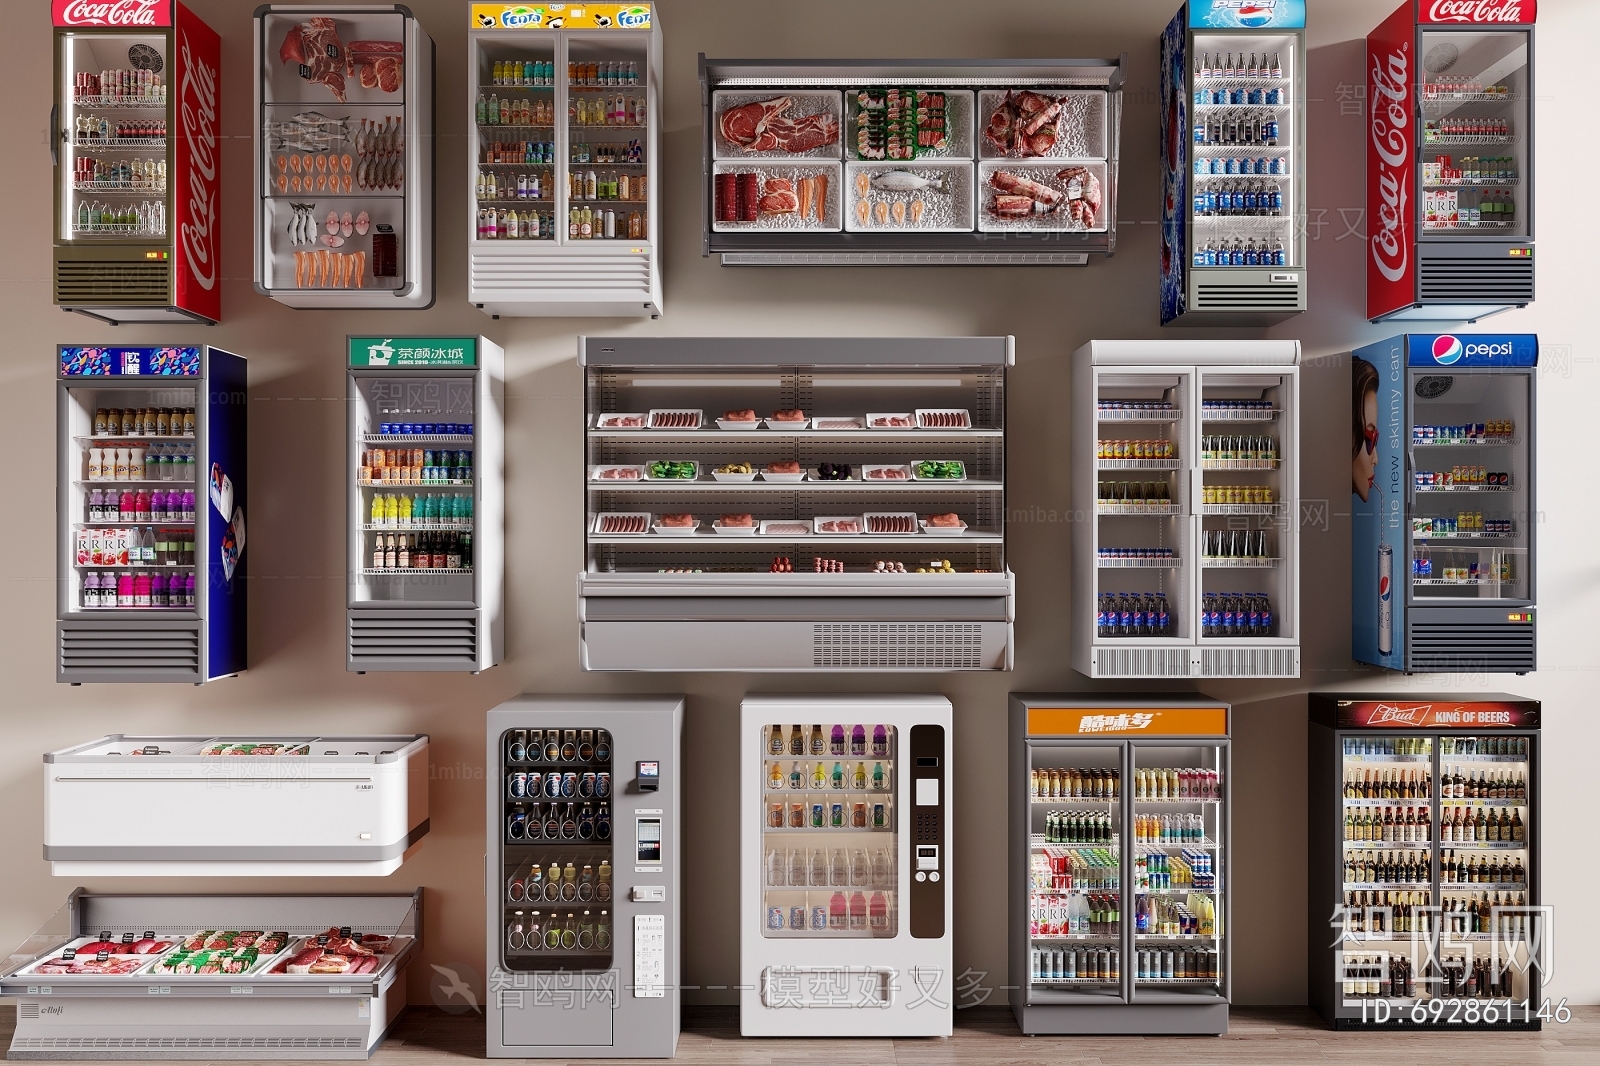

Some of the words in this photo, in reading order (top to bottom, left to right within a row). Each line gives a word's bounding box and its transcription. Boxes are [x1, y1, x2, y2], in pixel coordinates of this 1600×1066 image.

[181, 38, 216, 290] Coca-Cola
[1371, 48, 1408, 283] Coca-Cola
[1390, 347, 1400, 382] can
[1465, 341, 1512, 358] pepsi
[1388, 389, 1402, 449] skinny
[1390, 455, 1400, 494] new
[1388, 500, 1400, 529] the
[1079, 712, 1154, 729] 酷味多
[1378, 706, 1414, 721] Bud
[1435, 711, 1460, 723] KING
[1462, 711, 1476, 723] OF
[1478, 711, 1510, 723] BEERS
